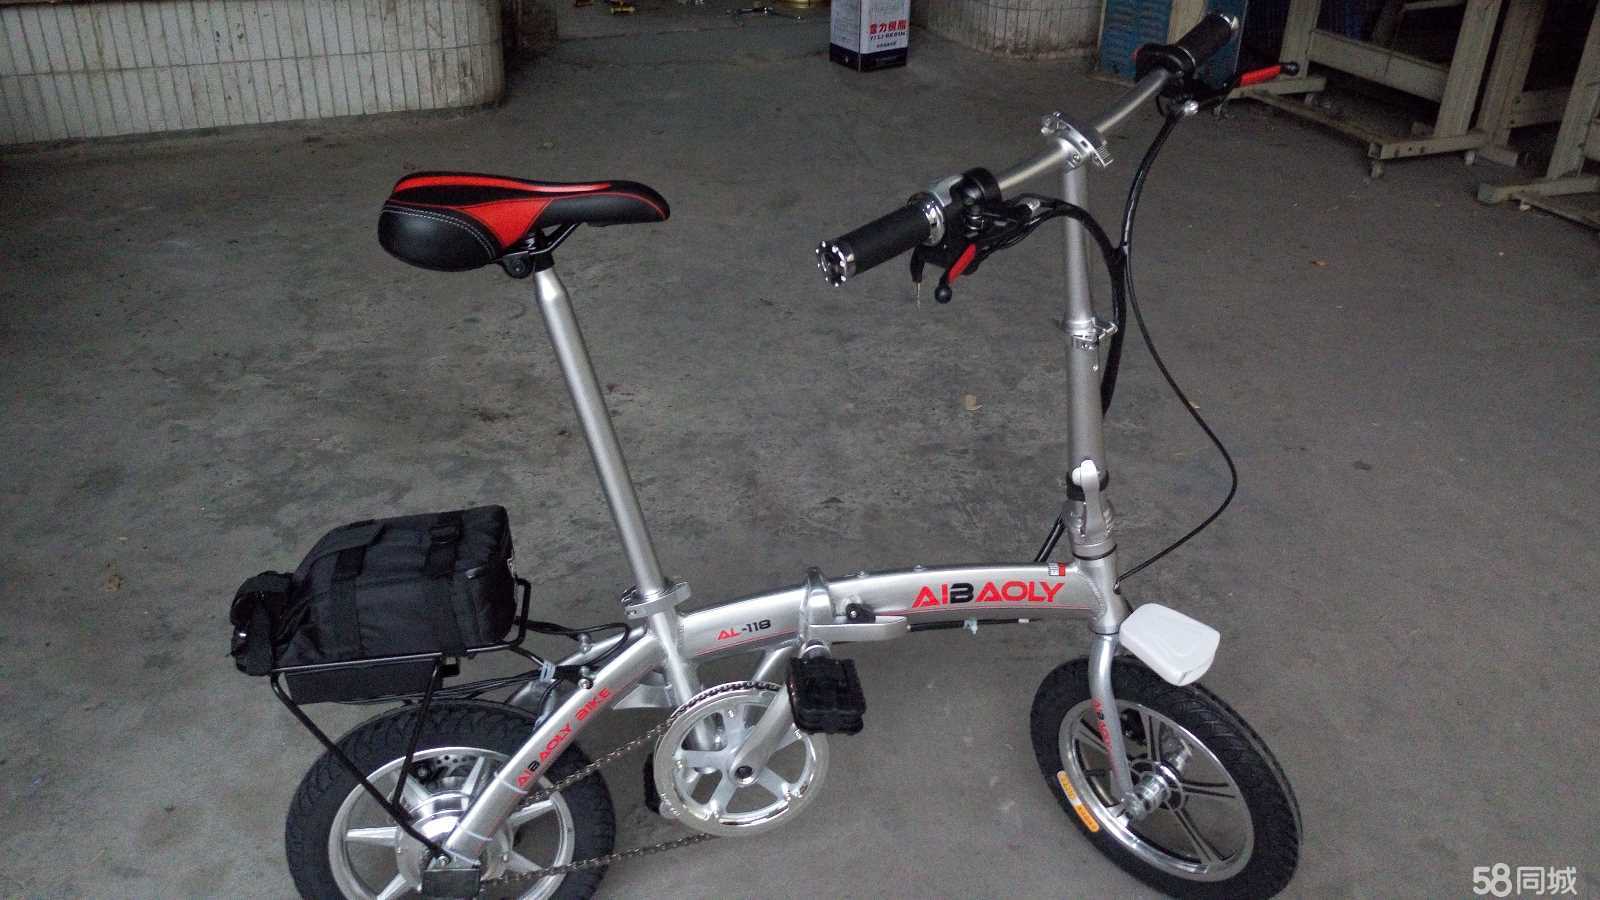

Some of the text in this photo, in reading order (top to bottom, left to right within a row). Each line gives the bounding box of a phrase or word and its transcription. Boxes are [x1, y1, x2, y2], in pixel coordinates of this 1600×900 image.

[912, 581, 1065, 608] AIBAOLY
[716, 619, 771, 640] AL-118
[515, 687, 611, 787] AIBAOLY BIKE
